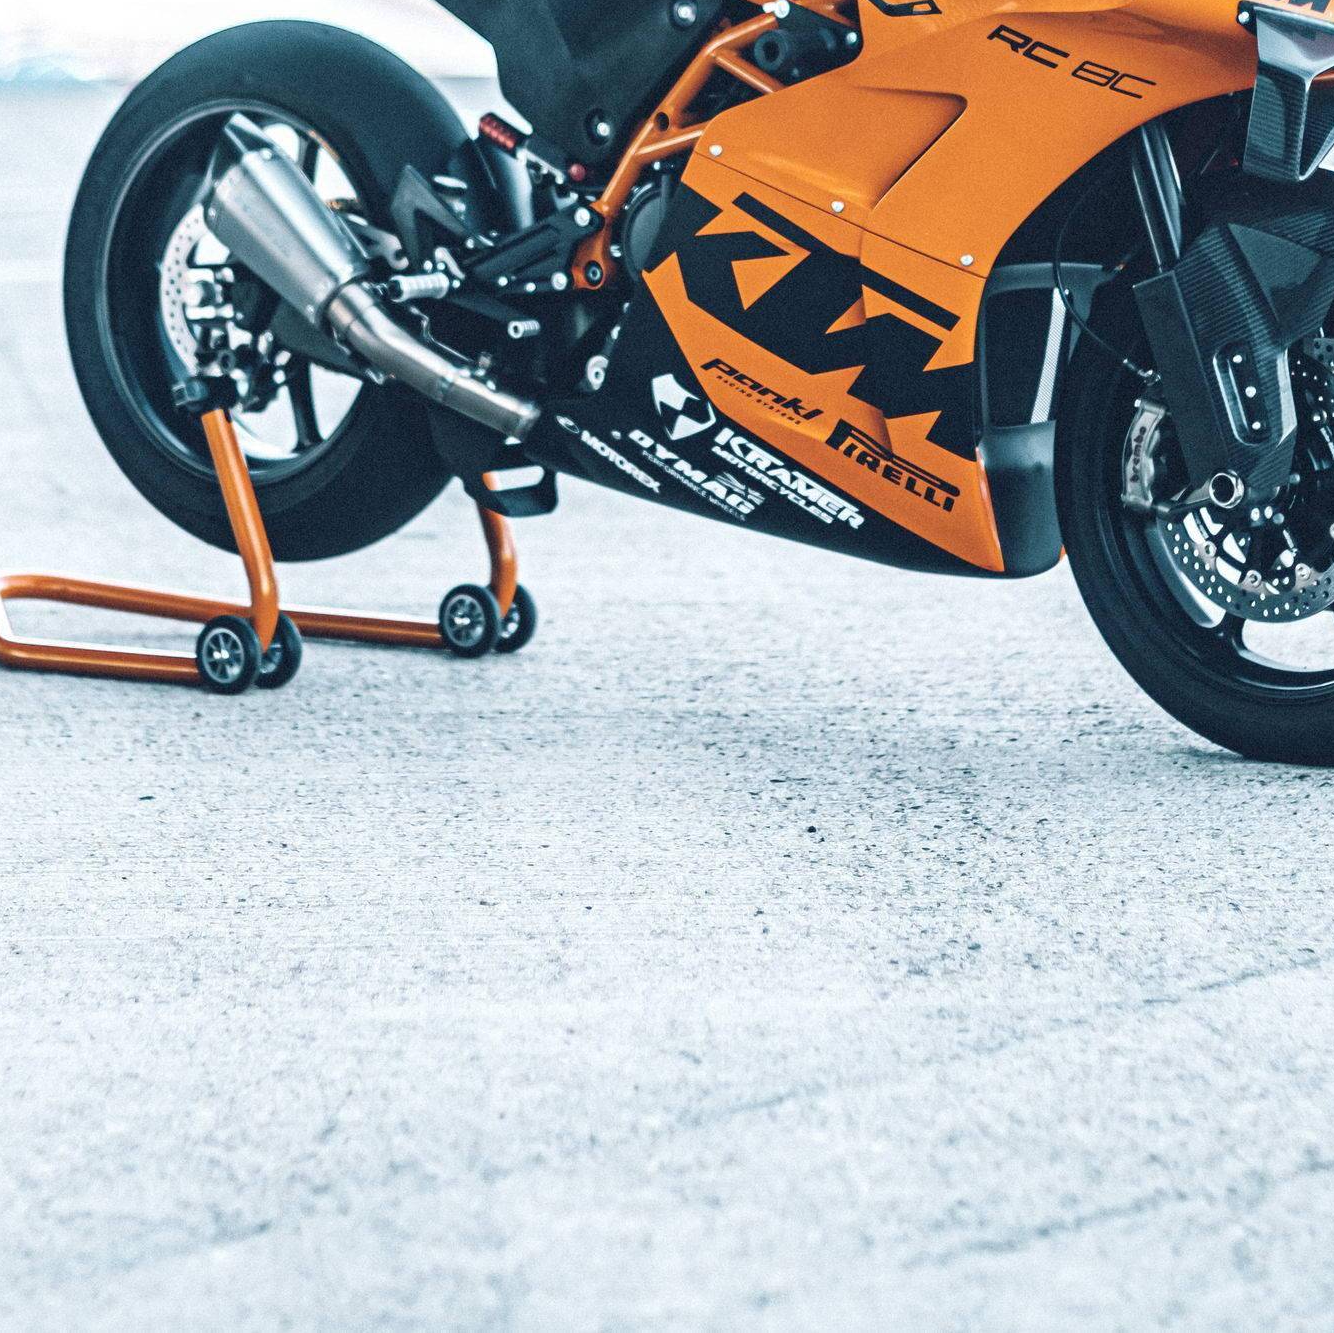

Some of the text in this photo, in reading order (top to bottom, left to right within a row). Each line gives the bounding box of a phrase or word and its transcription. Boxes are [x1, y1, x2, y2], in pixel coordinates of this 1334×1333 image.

[986, 24, 1157, 99] RC 8C
[648, 180, 979, 463] KTM
[700, 358, 825, 421] pankl
[715, 374, 802, 425] RACING SYSTEMS
[580, 429, 662, 495] MOTOREX
[627, 428, 756, 515] DYMAG
[641, 449, 746, 522] PERFORMANCE WHEELS
[711, 445, 834, 525] MOTORCYCLES
[825, 418, 961, 513] PIRELLI
